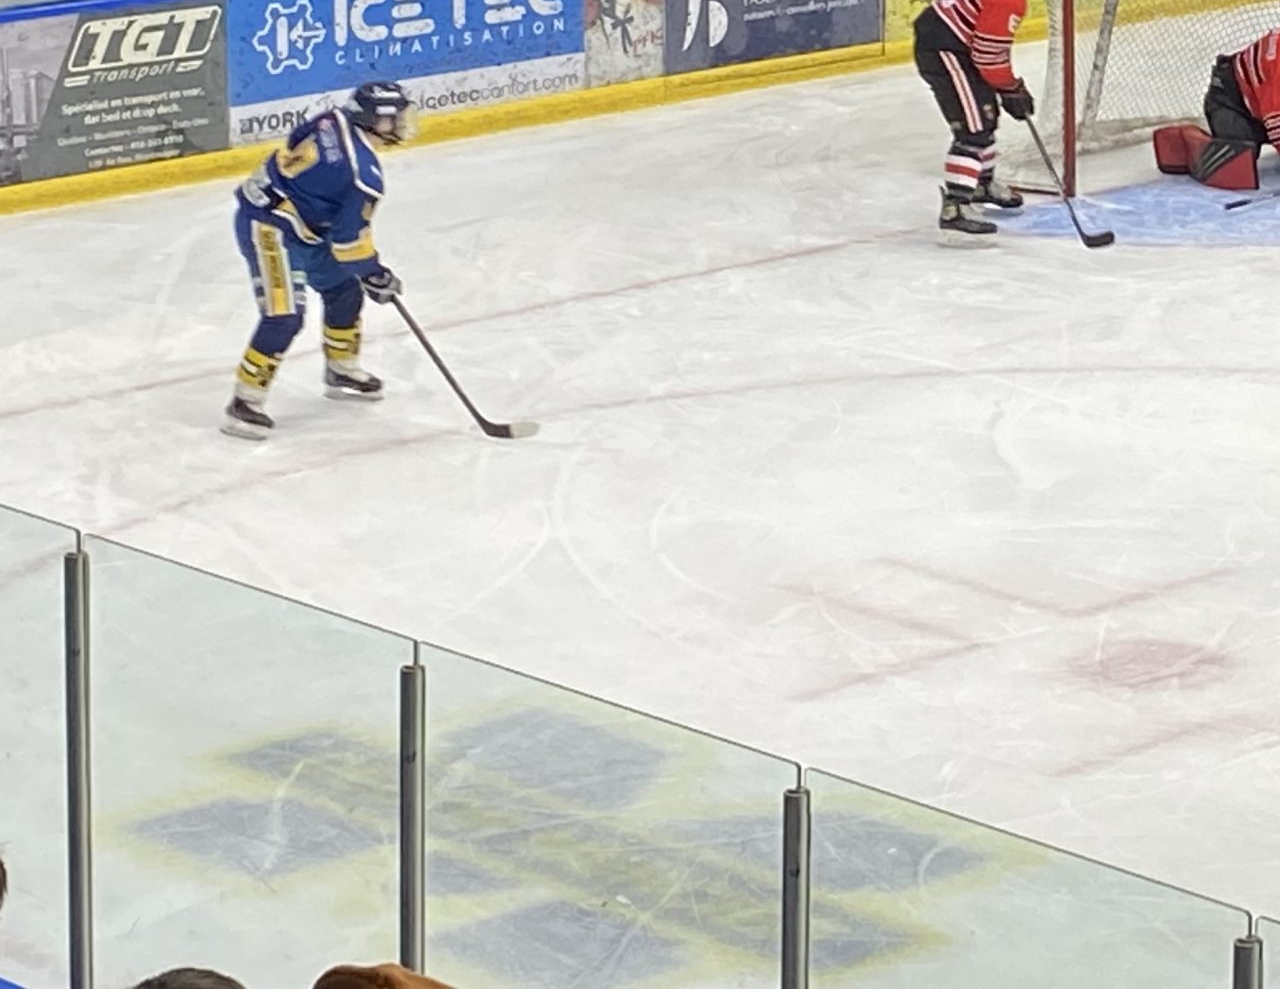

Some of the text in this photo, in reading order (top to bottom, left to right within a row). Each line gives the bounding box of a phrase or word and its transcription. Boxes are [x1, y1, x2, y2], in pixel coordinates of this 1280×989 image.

[85, 8, 212, 69] TGT
[335, 18, 566, 65] CLIMATISATION
[92, 61, 176, 84] Transport
[253, 107, 308, 133] YORK
